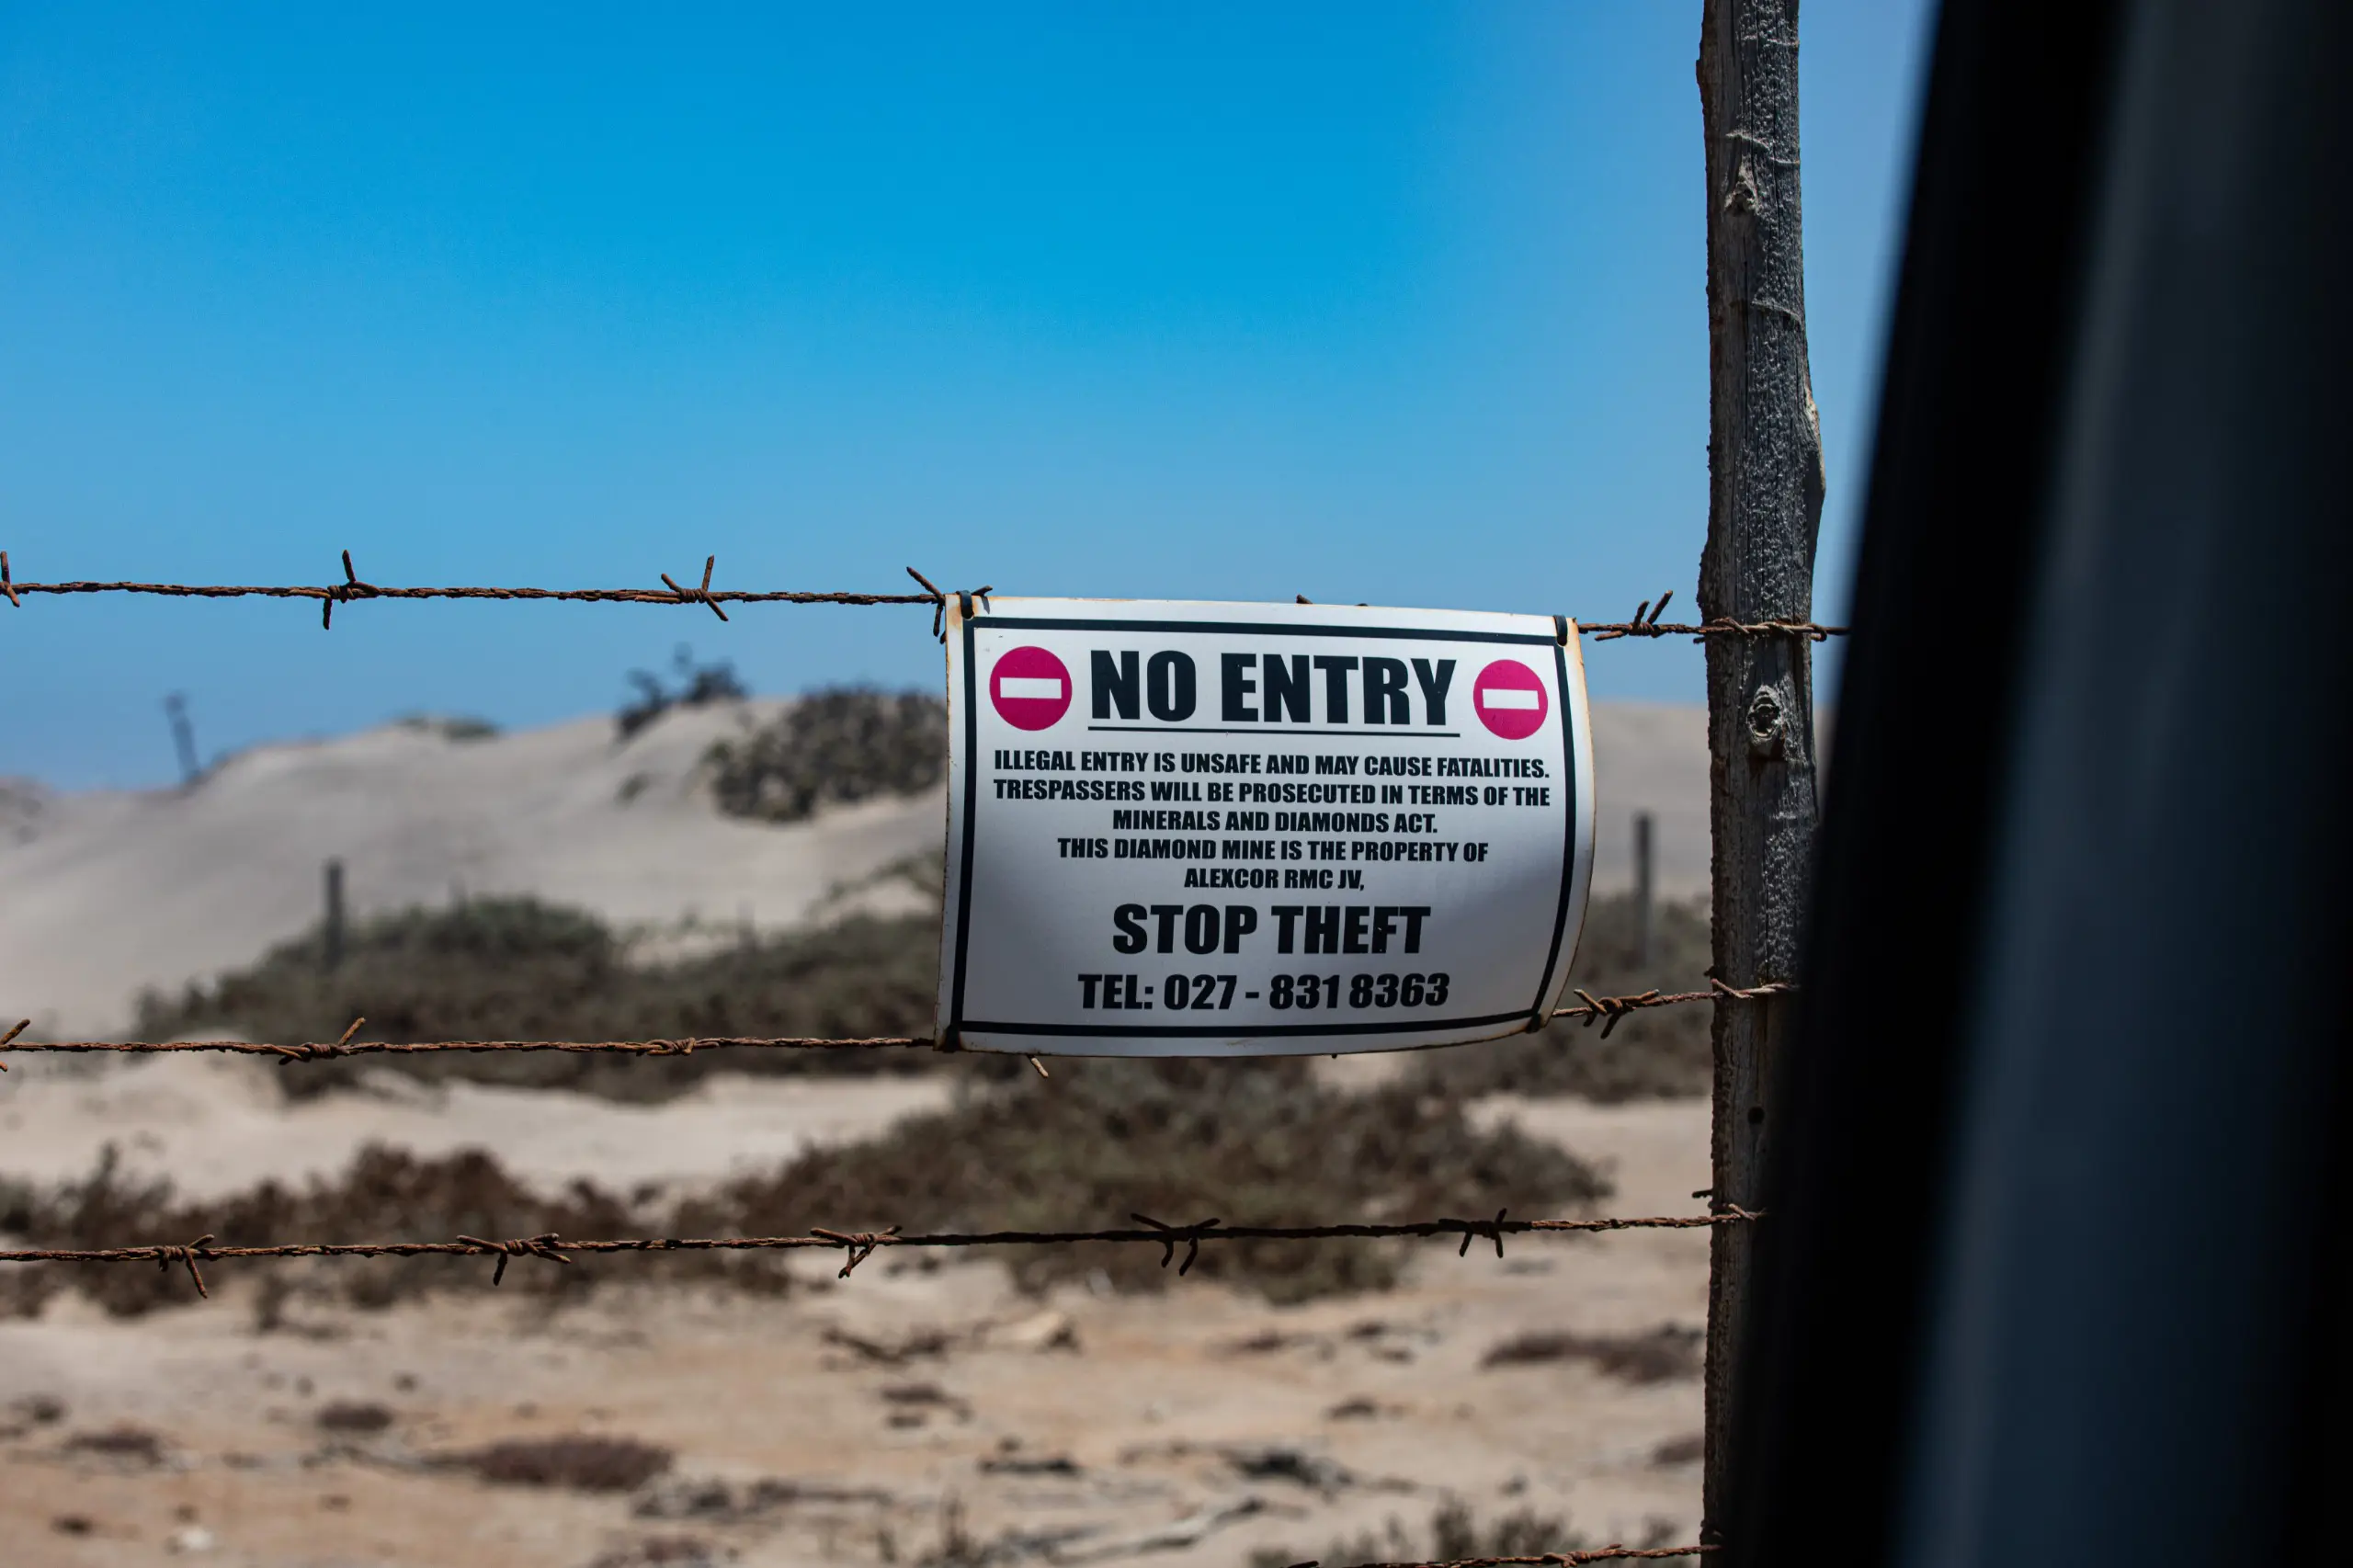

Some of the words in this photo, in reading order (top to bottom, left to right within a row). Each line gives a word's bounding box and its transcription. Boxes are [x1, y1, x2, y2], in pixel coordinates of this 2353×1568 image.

[1090, 650, 1196, 722] NO
[1221, 653, 1456, 725] ENTRY
[995, 749, 1075, 770] ILLEGAL
[1081, 751, 1148, 771] ENTRY
[1154, 752, 1175, 772] IS
[1181, 753, 1261, 773] UNSAFE
[1265, 754, 1309, 774] AND
[1314, 755, 1358, 775] MAY
[1364, 756, 1431, 776] CAUSE
[1437, 757, 1549, 778] FATALITIES.
[993, 778, 1144, 801] TRESPASSERS
[1150, 781, 1201, 801] WILL
[1207, 782, 1233, 801] BE
[1238, 782, 1375, 803] PROSECUTED
[1381, 784, 1402, 803] IN
[1407, 785, 1478, 805] TERMS
[1483, 786, 1507, 805] OF
[1512, 787, 1550, 806] THE
[1112, 809, 1220, 831] MINERALS
[1224, 811, 1268, 831] AND
[1275, 812, 1389, 833] DIAMONDS
[1392, 812, 1438, 833] ACT.
[1057, 837, 1108, 858] THIS
[1114, 838, 1216, 858] DIAMOND
[1222, 839, 1275, 859] MINE
[1280, 840, 1302, 860] IS
[1307, 840, 1346, 860] THE
[1351, 841, 1459, 861] PROPERTY
[1462, 842, 1488, 862] OF
[1183, 868, 1279, 888] ALEXCOR
[1284, 869, 1333, 889] RMC
[1337, 869, 1364, 891] JV,
[1112, 903, 1257, 955] STOP
[1270, 904, 1431, 954] THEFT
[1076, 972, 1154, 1010] TEL:
[1163, 973, 1237, 1010] 027
[1245, 991, 1259, 999] -
[1268, 973, 1340, 1010] 831
[1347, 971, 1450, 1011] 8363
